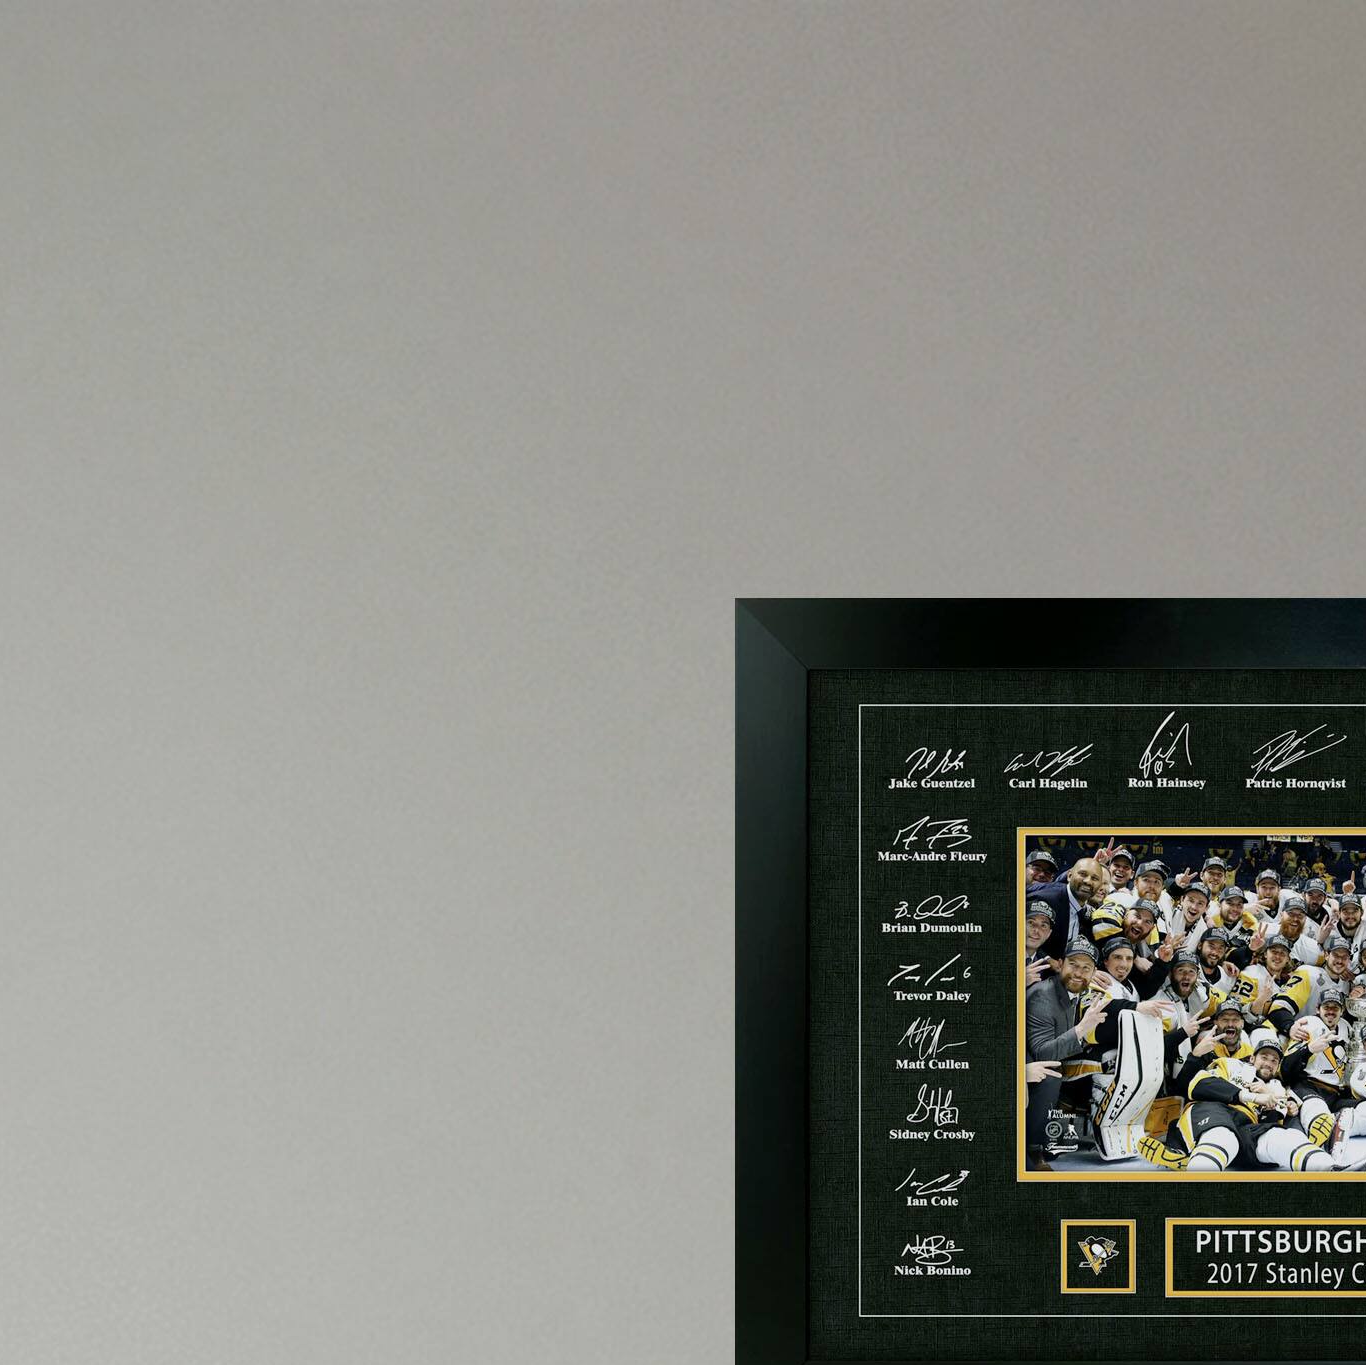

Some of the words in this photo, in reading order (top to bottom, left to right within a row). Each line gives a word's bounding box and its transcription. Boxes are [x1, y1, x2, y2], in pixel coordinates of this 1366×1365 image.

[888, 778, 917, 789] Jake
[921, 778, 975, 788] Guentzel
[1009, 778, 1035, 788] Carl
[1039, 778, 1087, 790] Hagelin
[1128, 778, 1153, 787] Ron
[1157, 778, 1206, 789] Hainsey
[1246, 778, 1282, 788] Patric
[1286, 778, 1346, 790] Hornqvist
[878, 852, 947, 861] Marc-Andre
[950, 852, 987, 863] Fleury
[882, 923, 916, 932] Brian
[920, 923, 982, 932] Dumoulin
[894, 991, 933, 1000] Trevor
[936, 991, 971, 1003] Daley
[896, 1060, 926, 1069] Matt
[929, 1060, 969, 1069] Cullen
[1109, 1084, 1128, 1120] CCM
[890, 1129, 930, 1141] Sidney
[934, 1129, 975, 1141] Crosby
[907, 1196, 929, 1206] Ian
[931, 1196, 959, 1206] Cole
[894, 1265, 923, 1275] Nick
[926, 1265, 971, 1275] Bonino
[1207, 1263, 1257, 1283] 2017
[1266, 1262, 1345, 1289] Stanley
